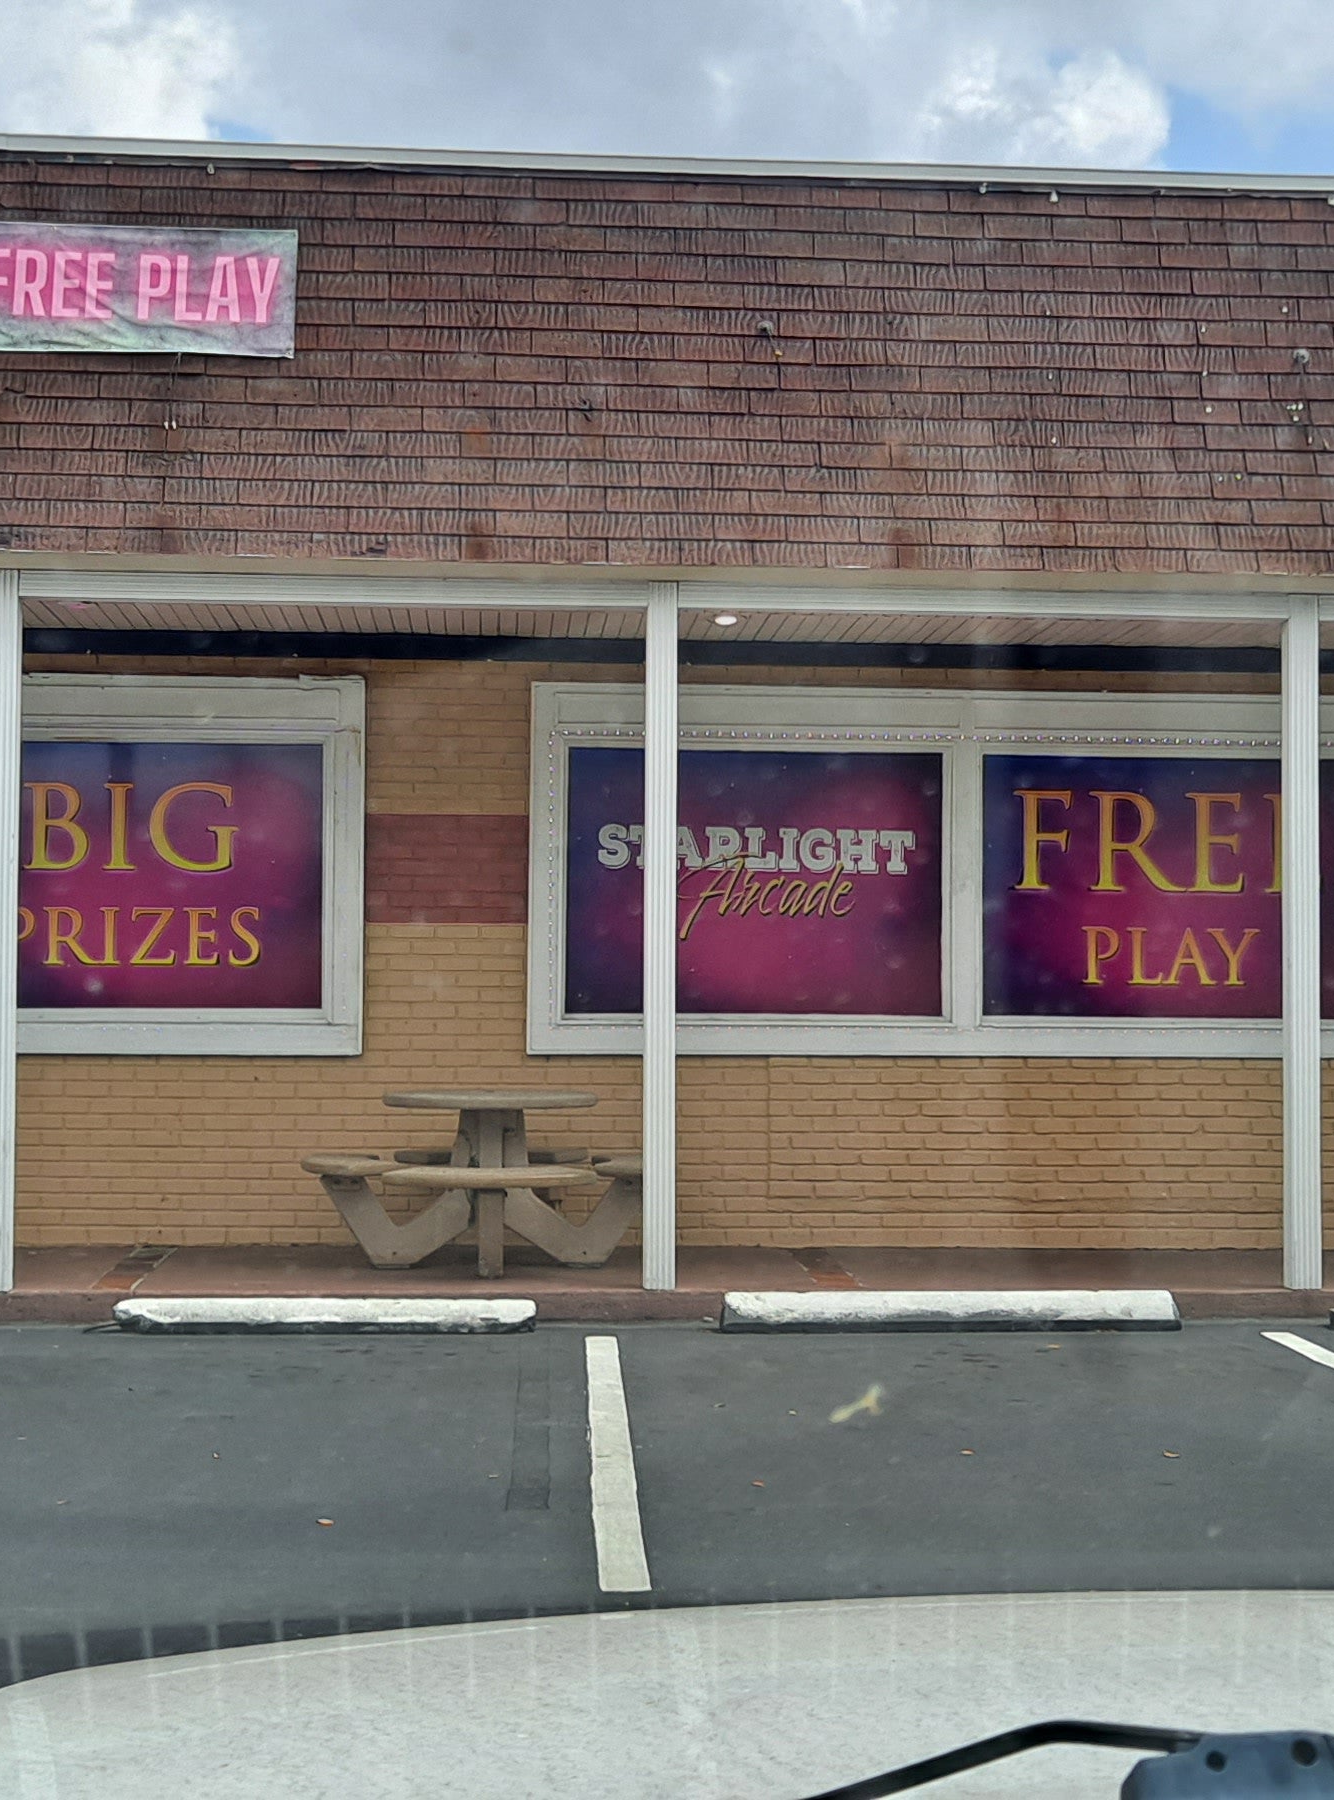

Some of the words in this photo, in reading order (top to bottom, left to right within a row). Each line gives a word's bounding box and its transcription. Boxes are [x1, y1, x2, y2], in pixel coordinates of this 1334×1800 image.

[135, 253, 280, 324] PLAY
[23, 781, 241, 873] BIG
[677, 852, 856, 940] Arcade
[1081, 925, 1261, 985] PLAY
